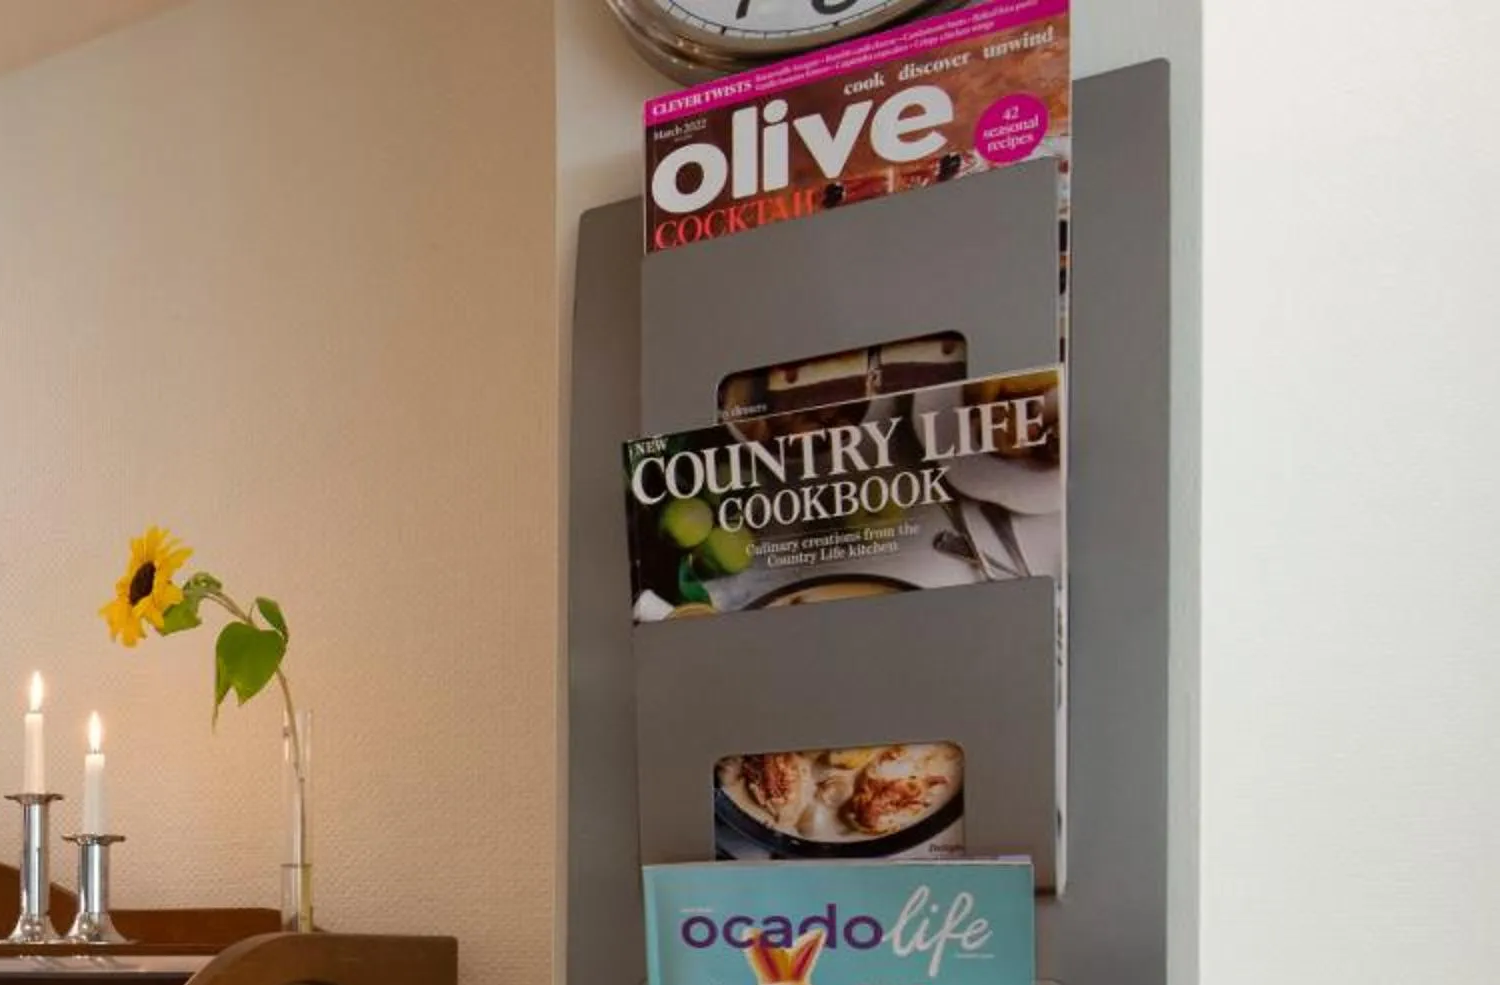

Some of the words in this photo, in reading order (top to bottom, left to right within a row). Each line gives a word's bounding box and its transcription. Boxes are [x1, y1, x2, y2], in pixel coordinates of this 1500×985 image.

[843, 72, 886, 96] cook
[898, 51, 972, 81] discover
[983, 25, 1054, 59] unwind
[653, 92, 702, 116] CLEVER
[704, 80, 753, 103] TWISTS
[1002, 104, 1020, 121] 42
[653, 124, 683, 141] March
[983, 115, 1039, 140] seasonal
[651, 85, 954, 214] olive
[987, 134, 1034, 154] recipes
[630, 416, 904, 506] COUNTRY
[919, 395, 1050, 463] LIFE
[634, 437, 668, 458] NEW
[717, 465, 953, 533] COOKBOOK
[746, 540, 799, 557] Culinary
[801, 531, 861, 548] creations
[863, 527, 896, 541] from
[899, 521, 919, 537] the
[767, 550, 817, 568] Country
[820, 547, 847, 561] Life
